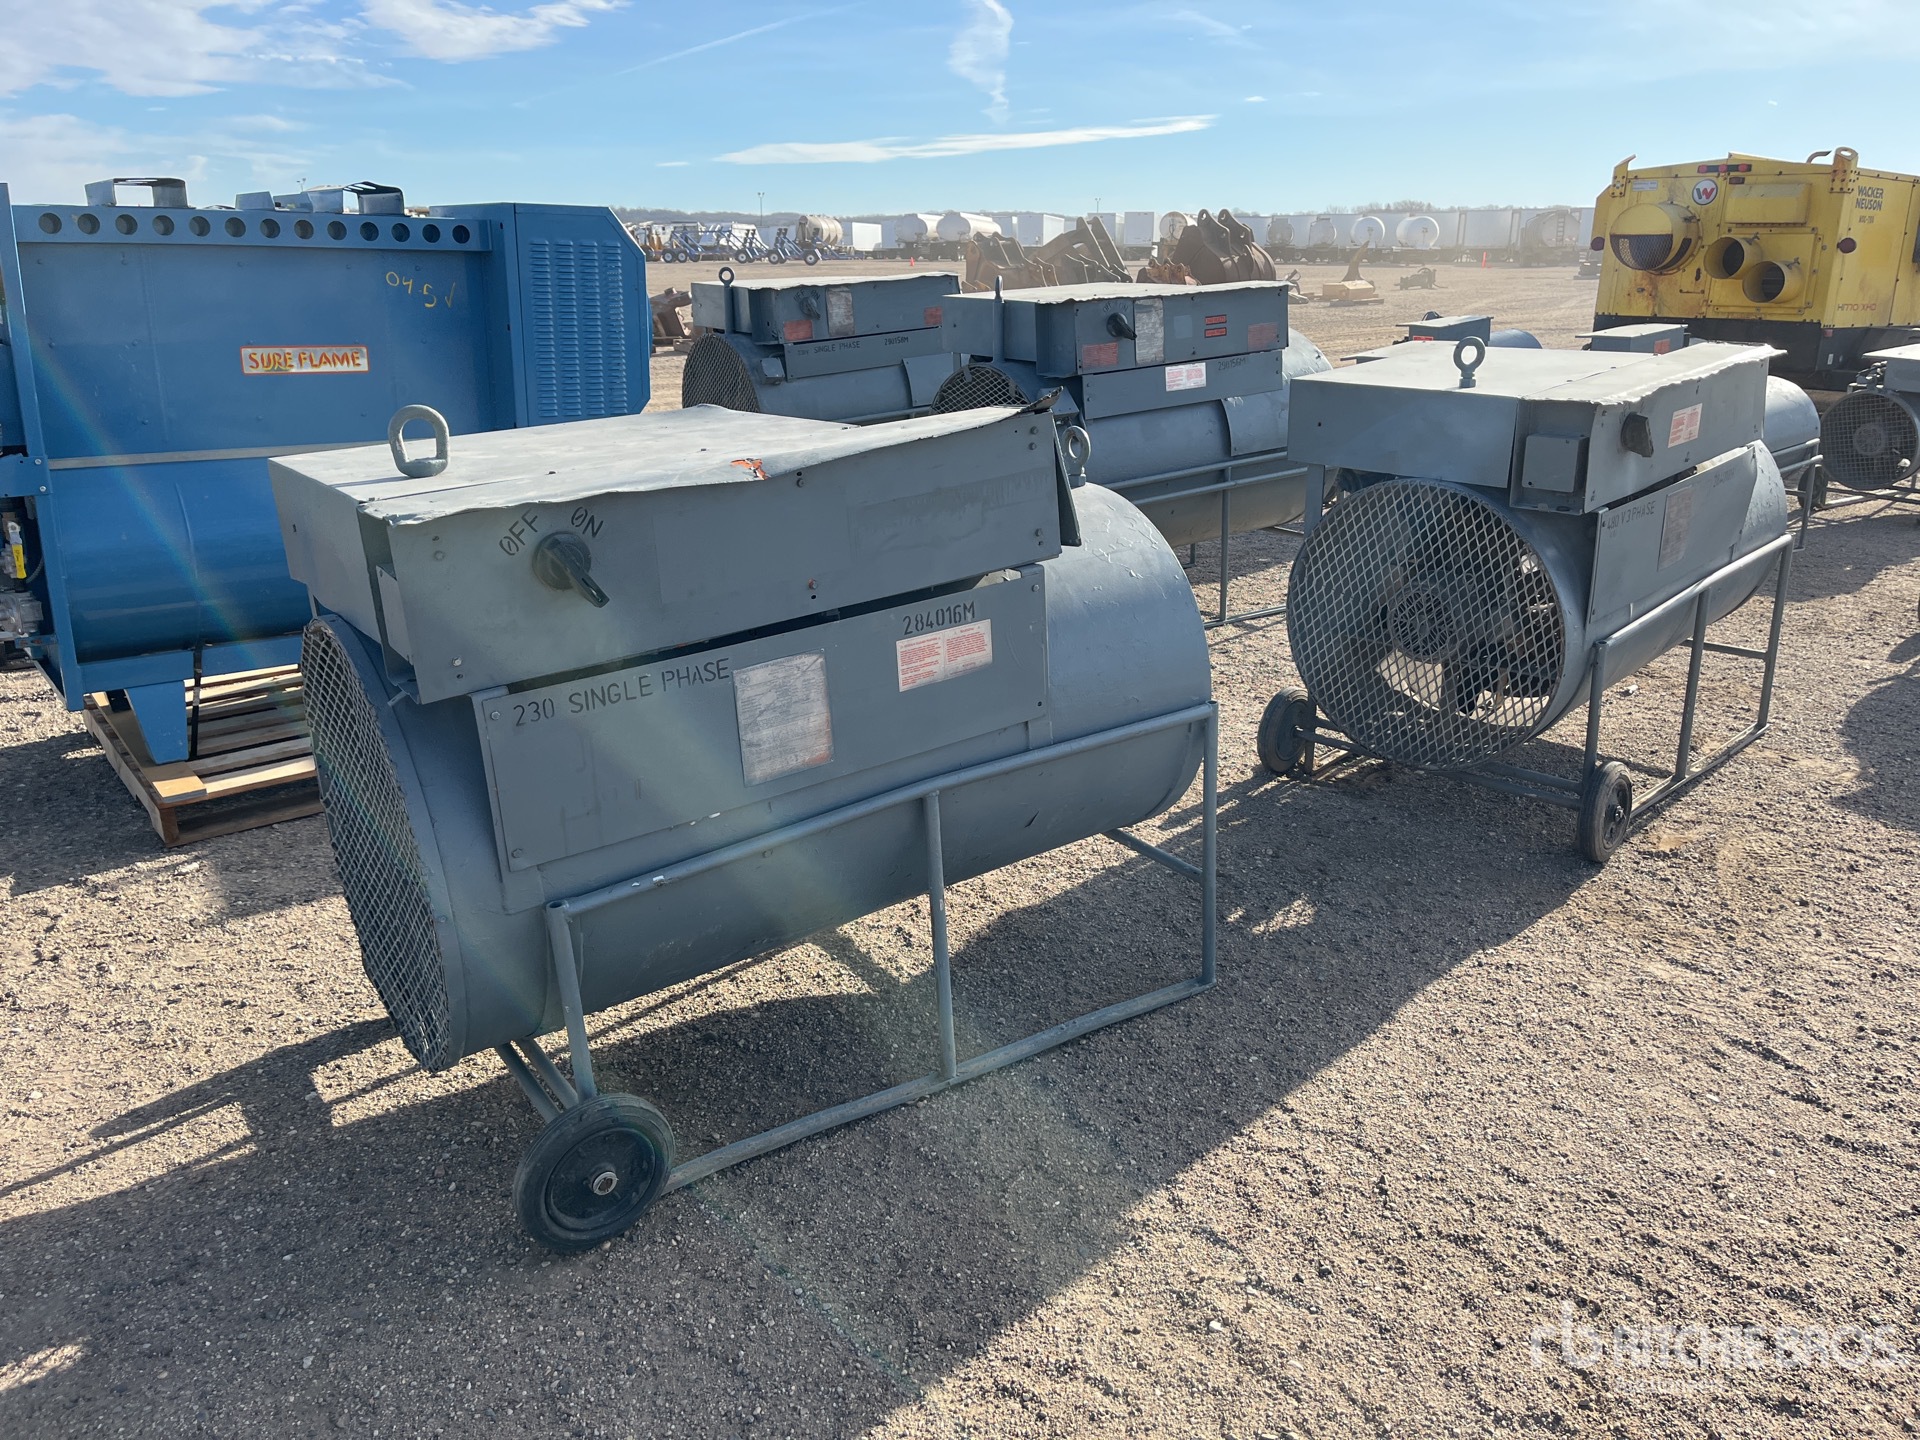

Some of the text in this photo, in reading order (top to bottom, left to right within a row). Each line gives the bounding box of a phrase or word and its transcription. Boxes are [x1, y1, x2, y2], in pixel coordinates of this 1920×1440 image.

[1858, 185, 1884, 200] WACKER
[1855, 197, 1883, 212] NEUSON
[813, 343, 836, 355] SINGLE
[839, 340, 861, 352] PHASE
[248, 350, 362, 371] SURE FLAME
[499, 505, 604, 557] OFF ON
[902, 600, 976, 636] 284016M
[513, 657, 732, 728] 230 SINGLE PHASE
